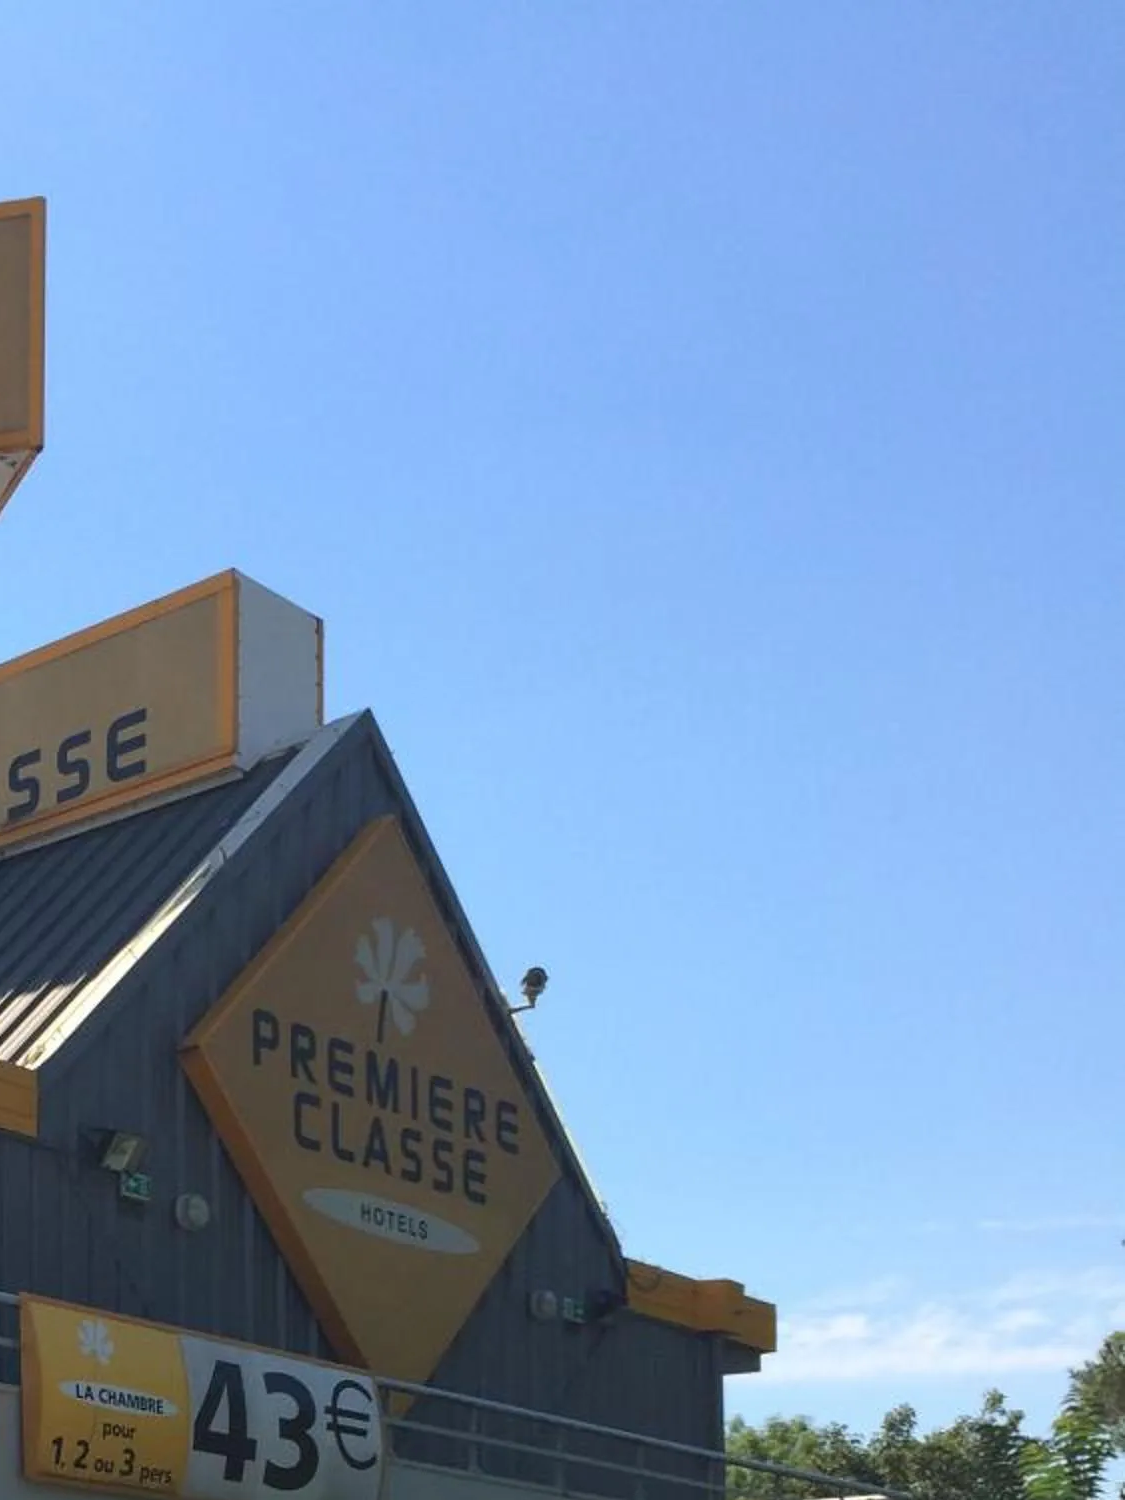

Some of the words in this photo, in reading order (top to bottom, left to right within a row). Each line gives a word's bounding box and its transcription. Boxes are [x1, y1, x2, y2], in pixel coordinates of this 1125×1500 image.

[252, 1009, 519, 1155] PREMIERE
[294, 1092, 487, 1206] CLASSE
[360, 1202, 429, 1240] HOTELS
[75, 1383, 94, 1401] LA
[98, 1388, 165, 1415] CHAMBRE
[102, 1422, 136, 1441] pour
[192, 1359, 379, 1491] 43€
[74, 1439, 91, 1469] 2
[94, 1456, 115, 1474] ou
[119, 1448, 136, 1477] 3
[139, 1462, 173, 1485] pers
